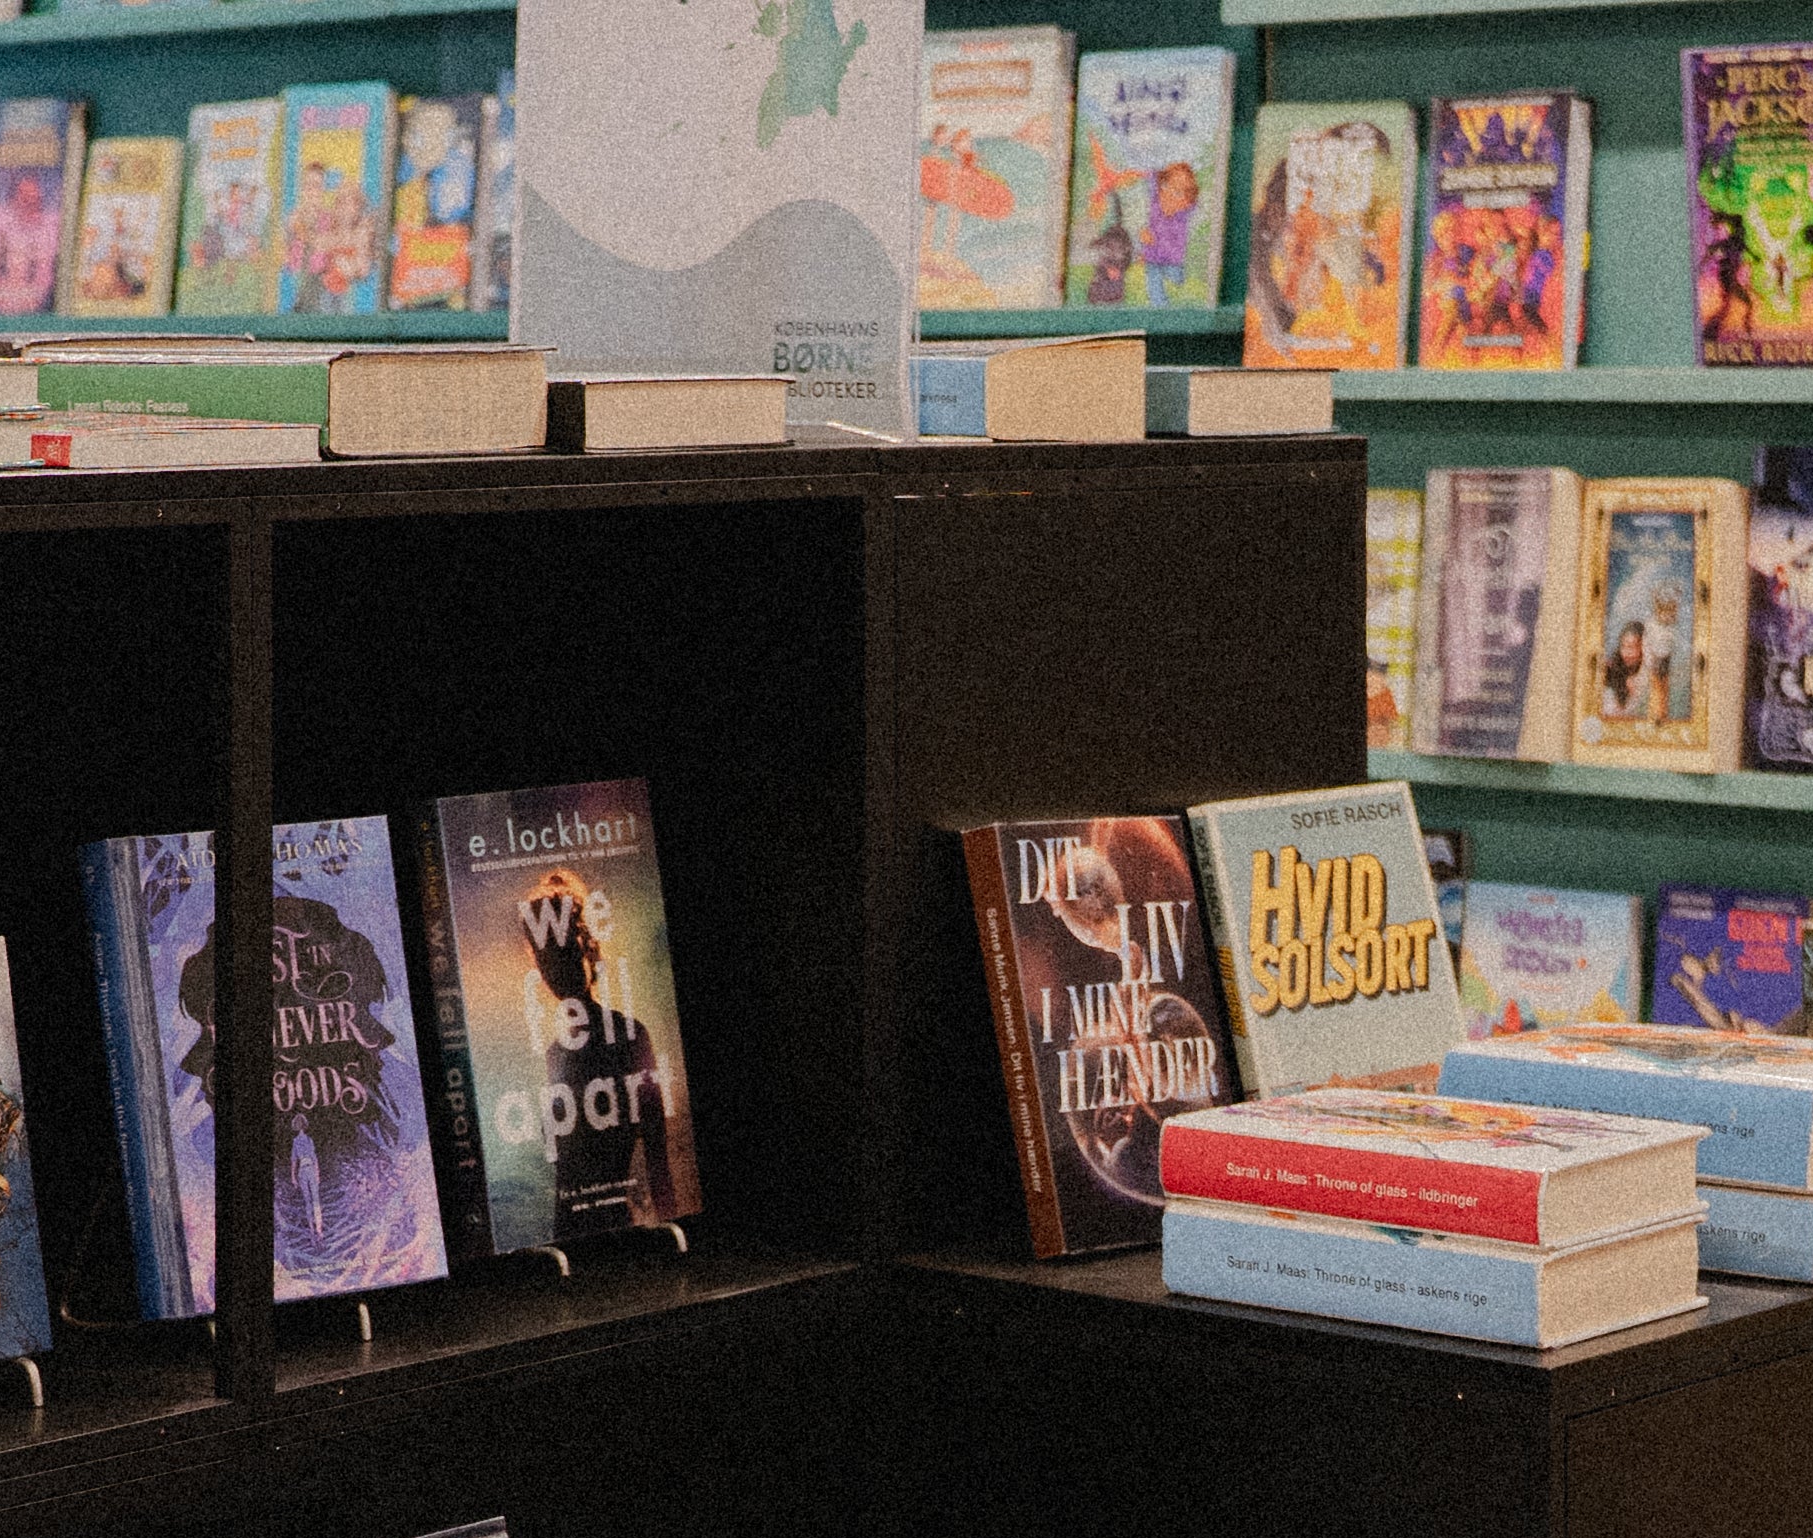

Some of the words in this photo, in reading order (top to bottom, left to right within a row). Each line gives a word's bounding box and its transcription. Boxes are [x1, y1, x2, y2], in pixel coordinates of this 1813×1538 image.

[773, 321, 879, 337] KØBENHAVNS
[1290, 806, 1342, 833] SOFIE
[1344, 800, 1403, 827] RASCH
[1017, 836, 1087, 904] DIT
[1249, 845, 1389, 953] HVID
[517, 888, 614, 952] we
[1116, 899, 1193, 987] LIV
[1249, 918, 1438, 1018] SOLSORT
[272, 1000, 380, 1050] EVER
[523, 955, 636, 1056] fell
[1039, 986, 1054, 1044] I
[1066, 980, 1154, 1043] MINE
[272, 1062, 369, 1115] OODS
[1057, 1034, 1221, 1115] HÆNDER
[493, 1052, 675, 1163] apart
[1226, 1162, 1261, 1180] Sarah
[1276, 1168, 1311, 1187] Maas:
[1314, 1173, 1358, 1193] Throne
[1359, 1180, 1373, 1194] of
[1375, 1183, 1409, 1200] glass
[1418, 1183, 1479, 1208] ildbringer
[1226, 1255, 1260, 1273] Sarah
[1314, 1267, 1357, 1287] Throne
[1359, 1275, 1373, 1288] of
[1374, 1278, 1408, 1295] glass
[1417, 1284, 1461, 1303] askens
[1463, 1291, 1488, 1308] rige
